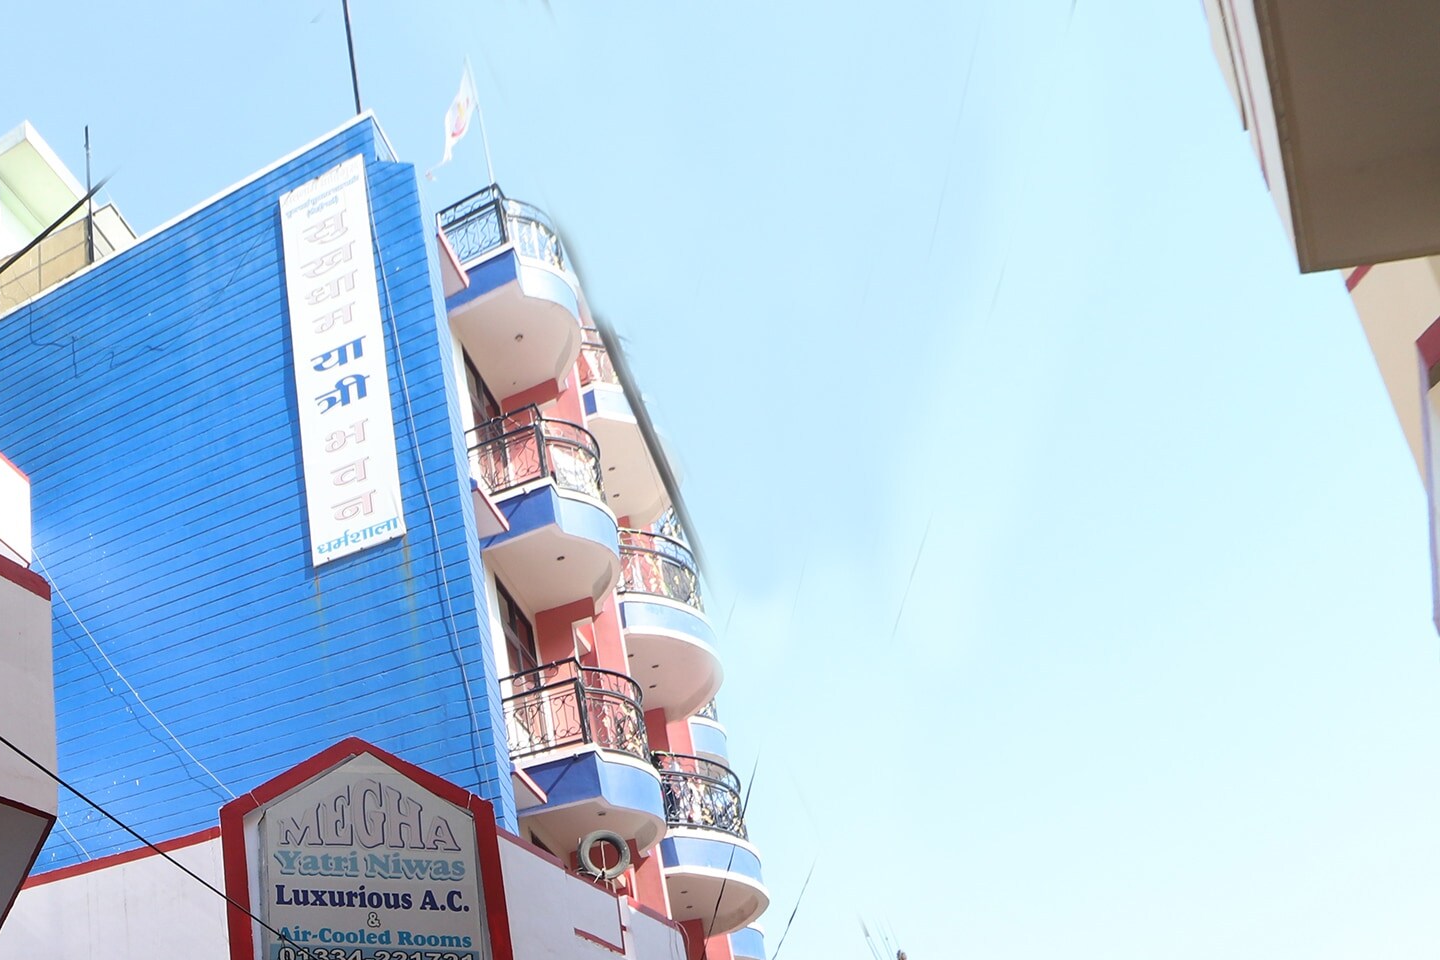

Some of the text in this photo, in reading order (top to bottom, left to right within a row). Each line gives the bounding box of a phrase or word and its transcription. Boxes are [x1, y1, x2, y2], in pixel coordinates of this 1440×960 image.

[317, 516, 400, 555] धर्मशाला
[277, 779, 462, 851] MEGHA
[274, 850, 466, 881] Yatri Niwas
[275, 884, 470, 912] Luxurious A.C.
[367, 912, 382, 928] &
[277, 926, 472, 948] Air-Cooled Rooms
